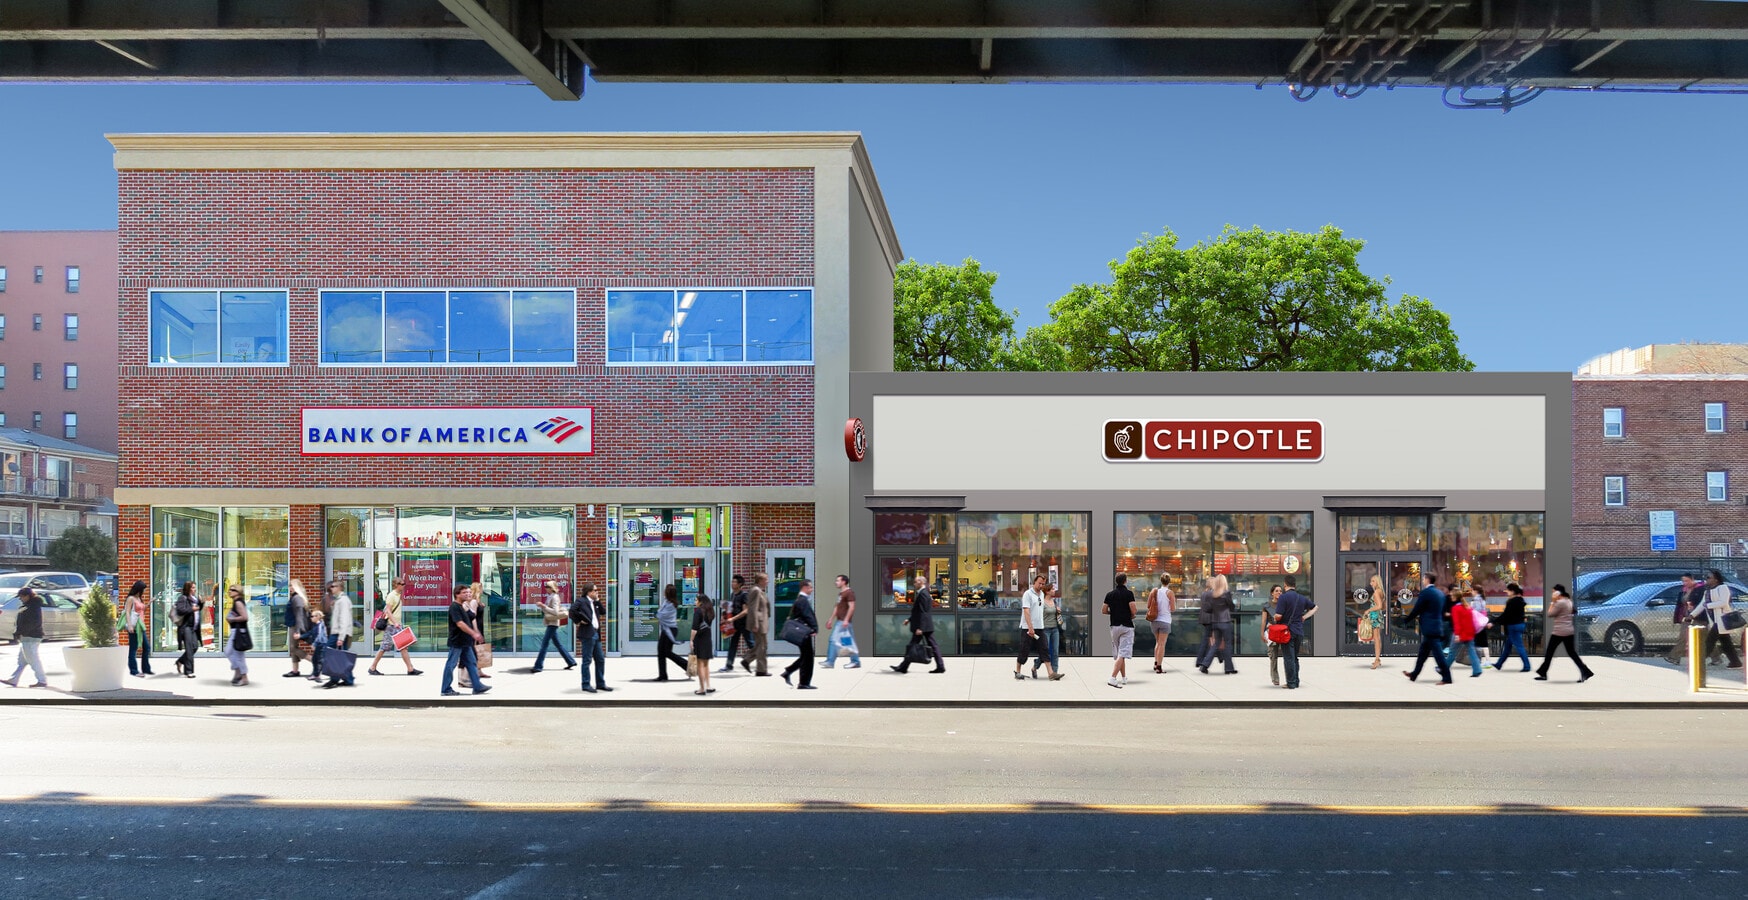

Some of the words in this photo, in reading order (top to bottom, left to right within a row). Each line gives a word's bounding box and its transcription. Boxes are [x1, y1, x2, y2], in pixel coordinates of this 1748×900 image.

[308, 427, 374, 443] BANK
[381, 427, 411, 443] OF
[417, 427, 528, 443] AMERICA
[1153, 429, 1313, 450] CHIPOTLE
